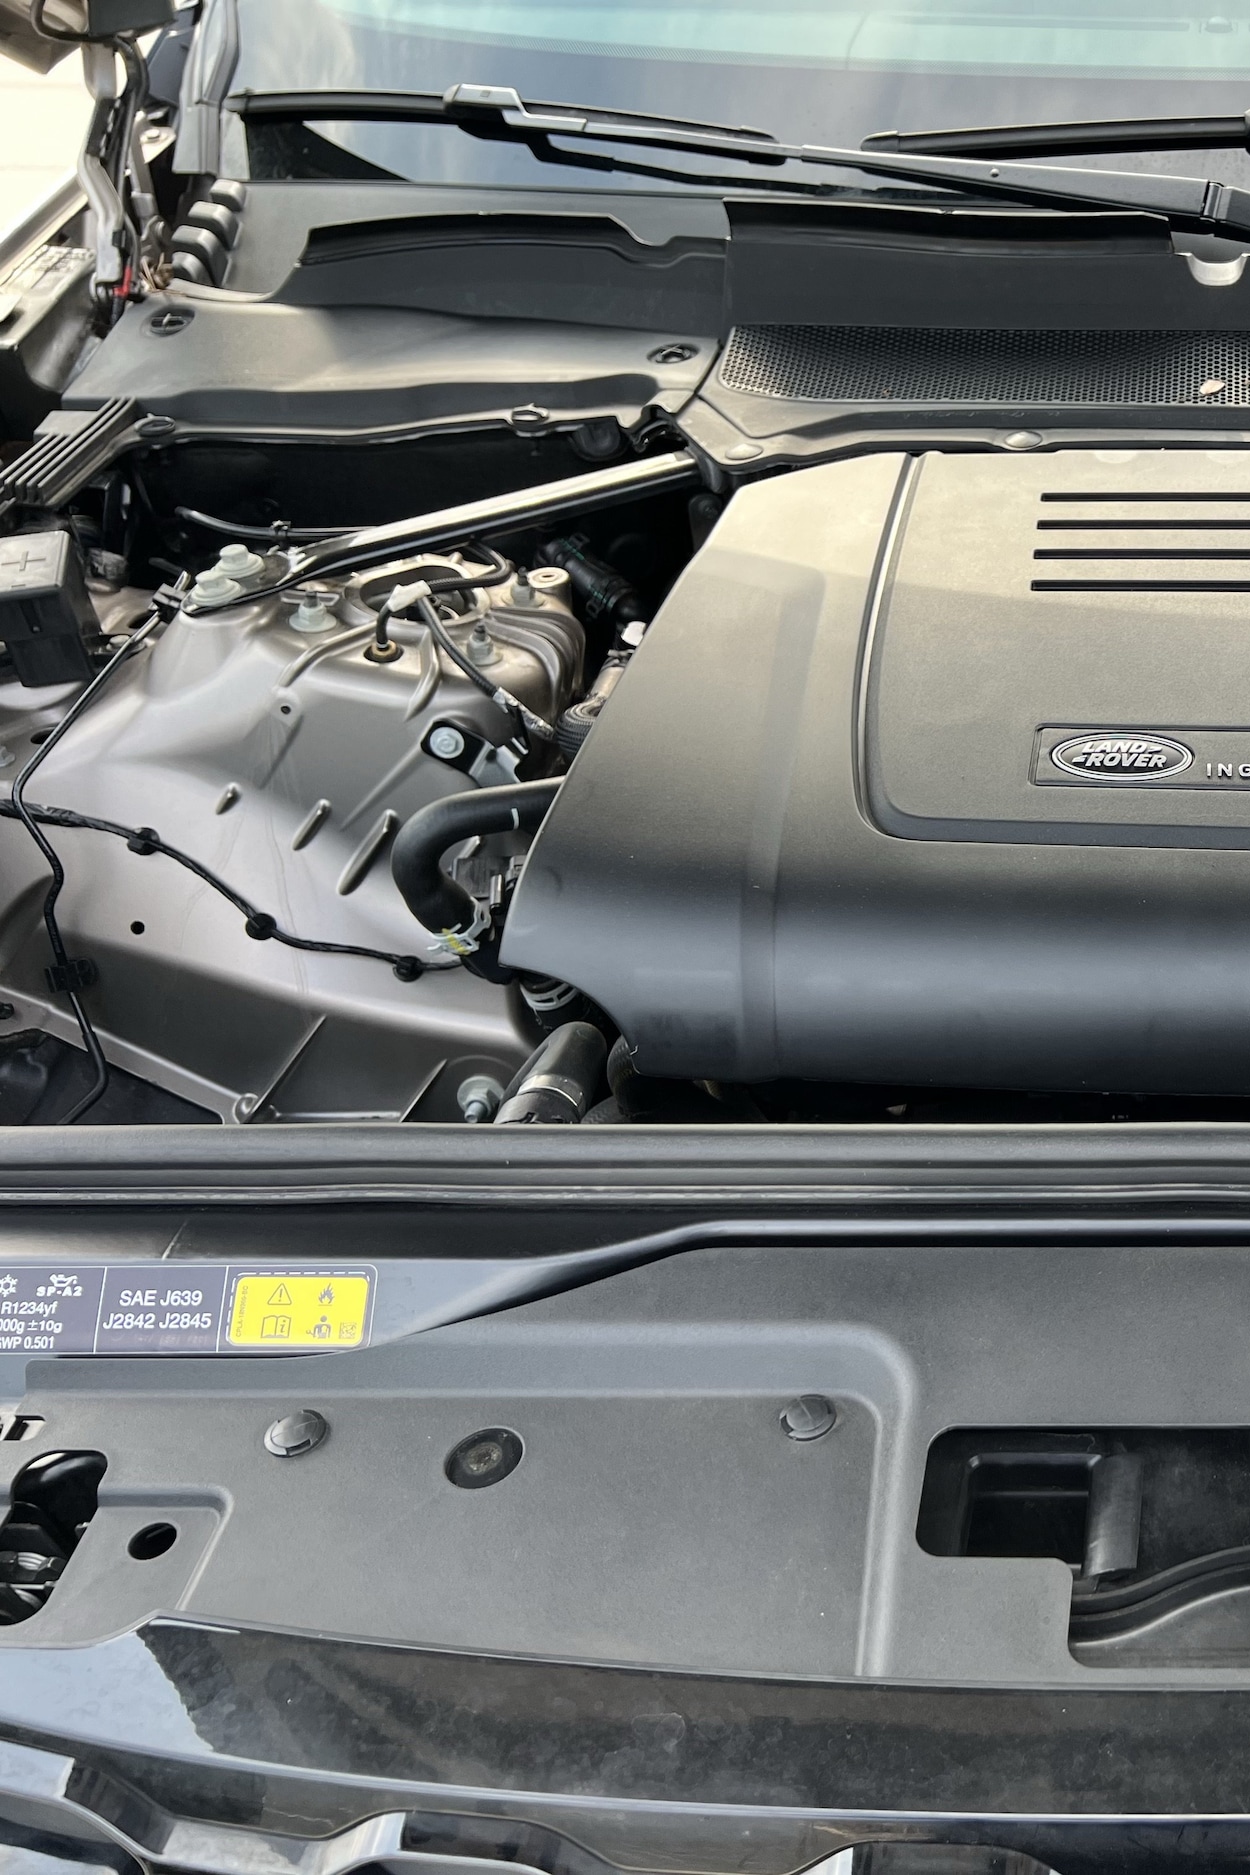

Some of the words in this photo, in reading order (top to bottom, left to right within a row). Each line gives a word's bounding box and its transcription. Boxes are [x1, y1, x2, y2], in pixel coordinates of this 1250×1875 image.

[1081, 741, 1147, 754] LAND
[1084, 752, 1168, 768] ROVER
[36, 1286, 83, 1297] SP-A2
[119, 1289, 157, 1306] SAE
[160, 1289, 203, 1306] J639
[1, 1300, 59, 1317] R1234yf
[27, 1319, 63, 1334] ±10g
[102, 1312, 156, 1329] J2842
[159, 1312, 212, 1329] J2845
[0, 1336, 22, 1350] WP
[23, 1335, 55, 1349] 0.501
